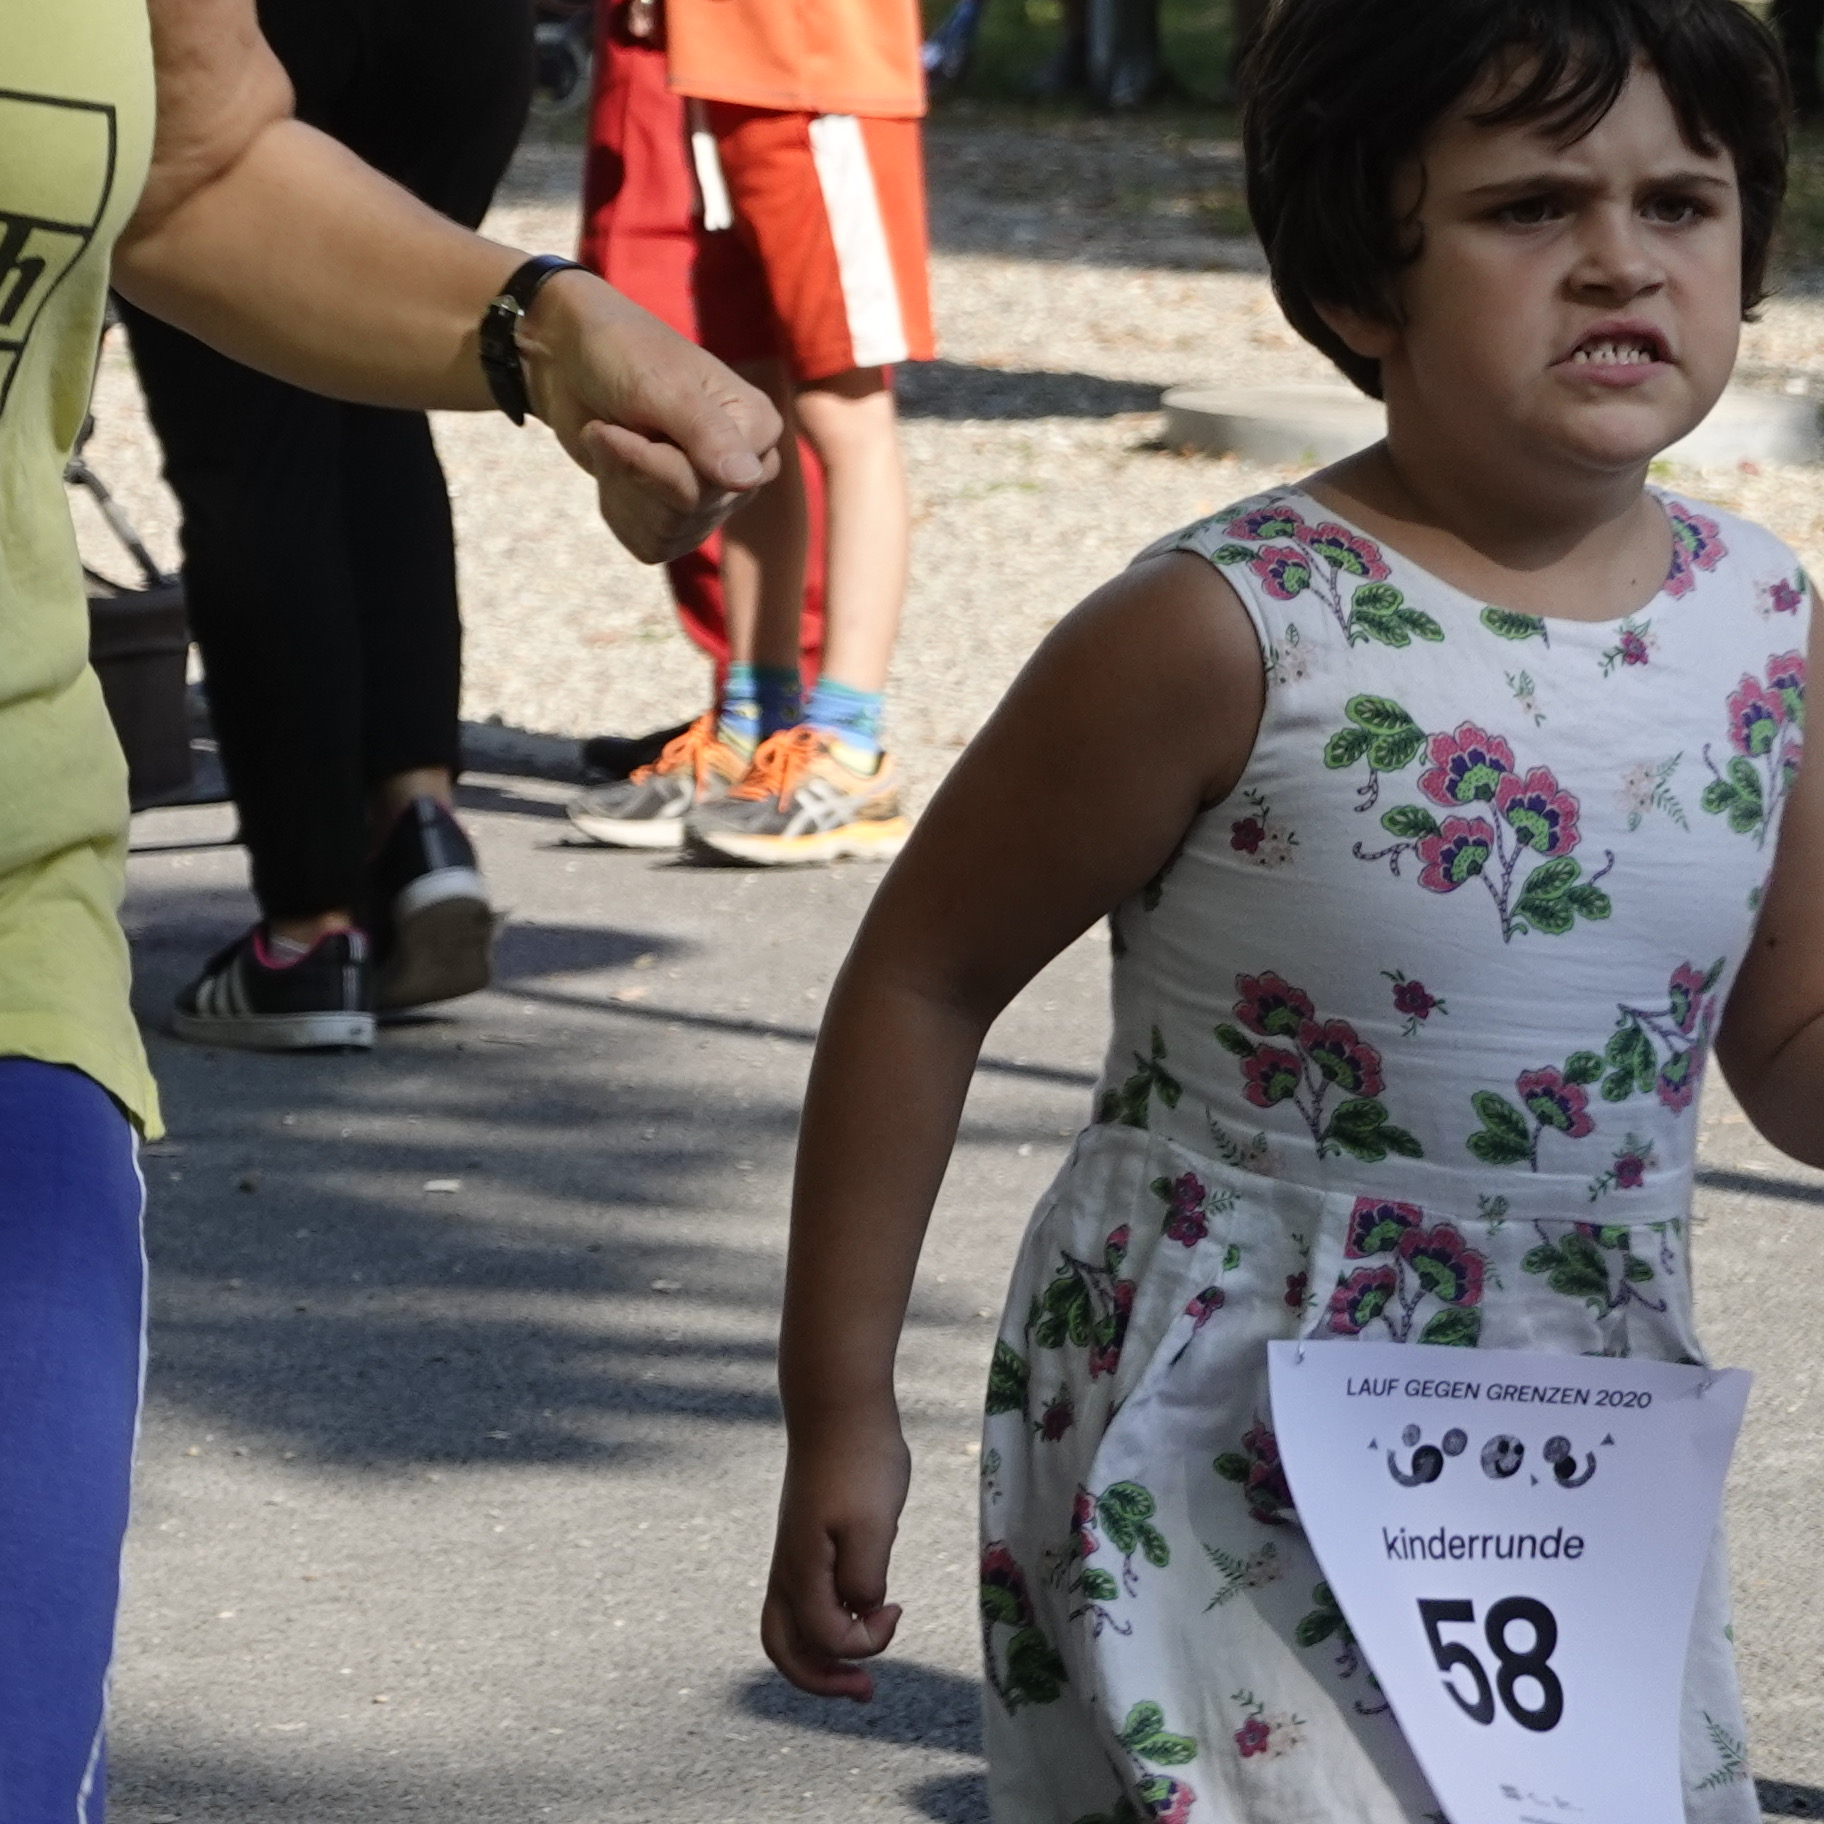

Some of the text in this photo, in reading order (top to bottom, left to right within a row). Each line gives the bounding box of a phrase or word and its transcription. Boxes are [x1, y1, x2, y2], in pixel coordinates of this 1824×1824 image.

[1346, 1378, 1652, 1409] LAUF GEGEN GRENZEN 2020
[1383, 1527, 1584, 1560] kinderrunde
[1416, 1595, 1564, 1733] 58
